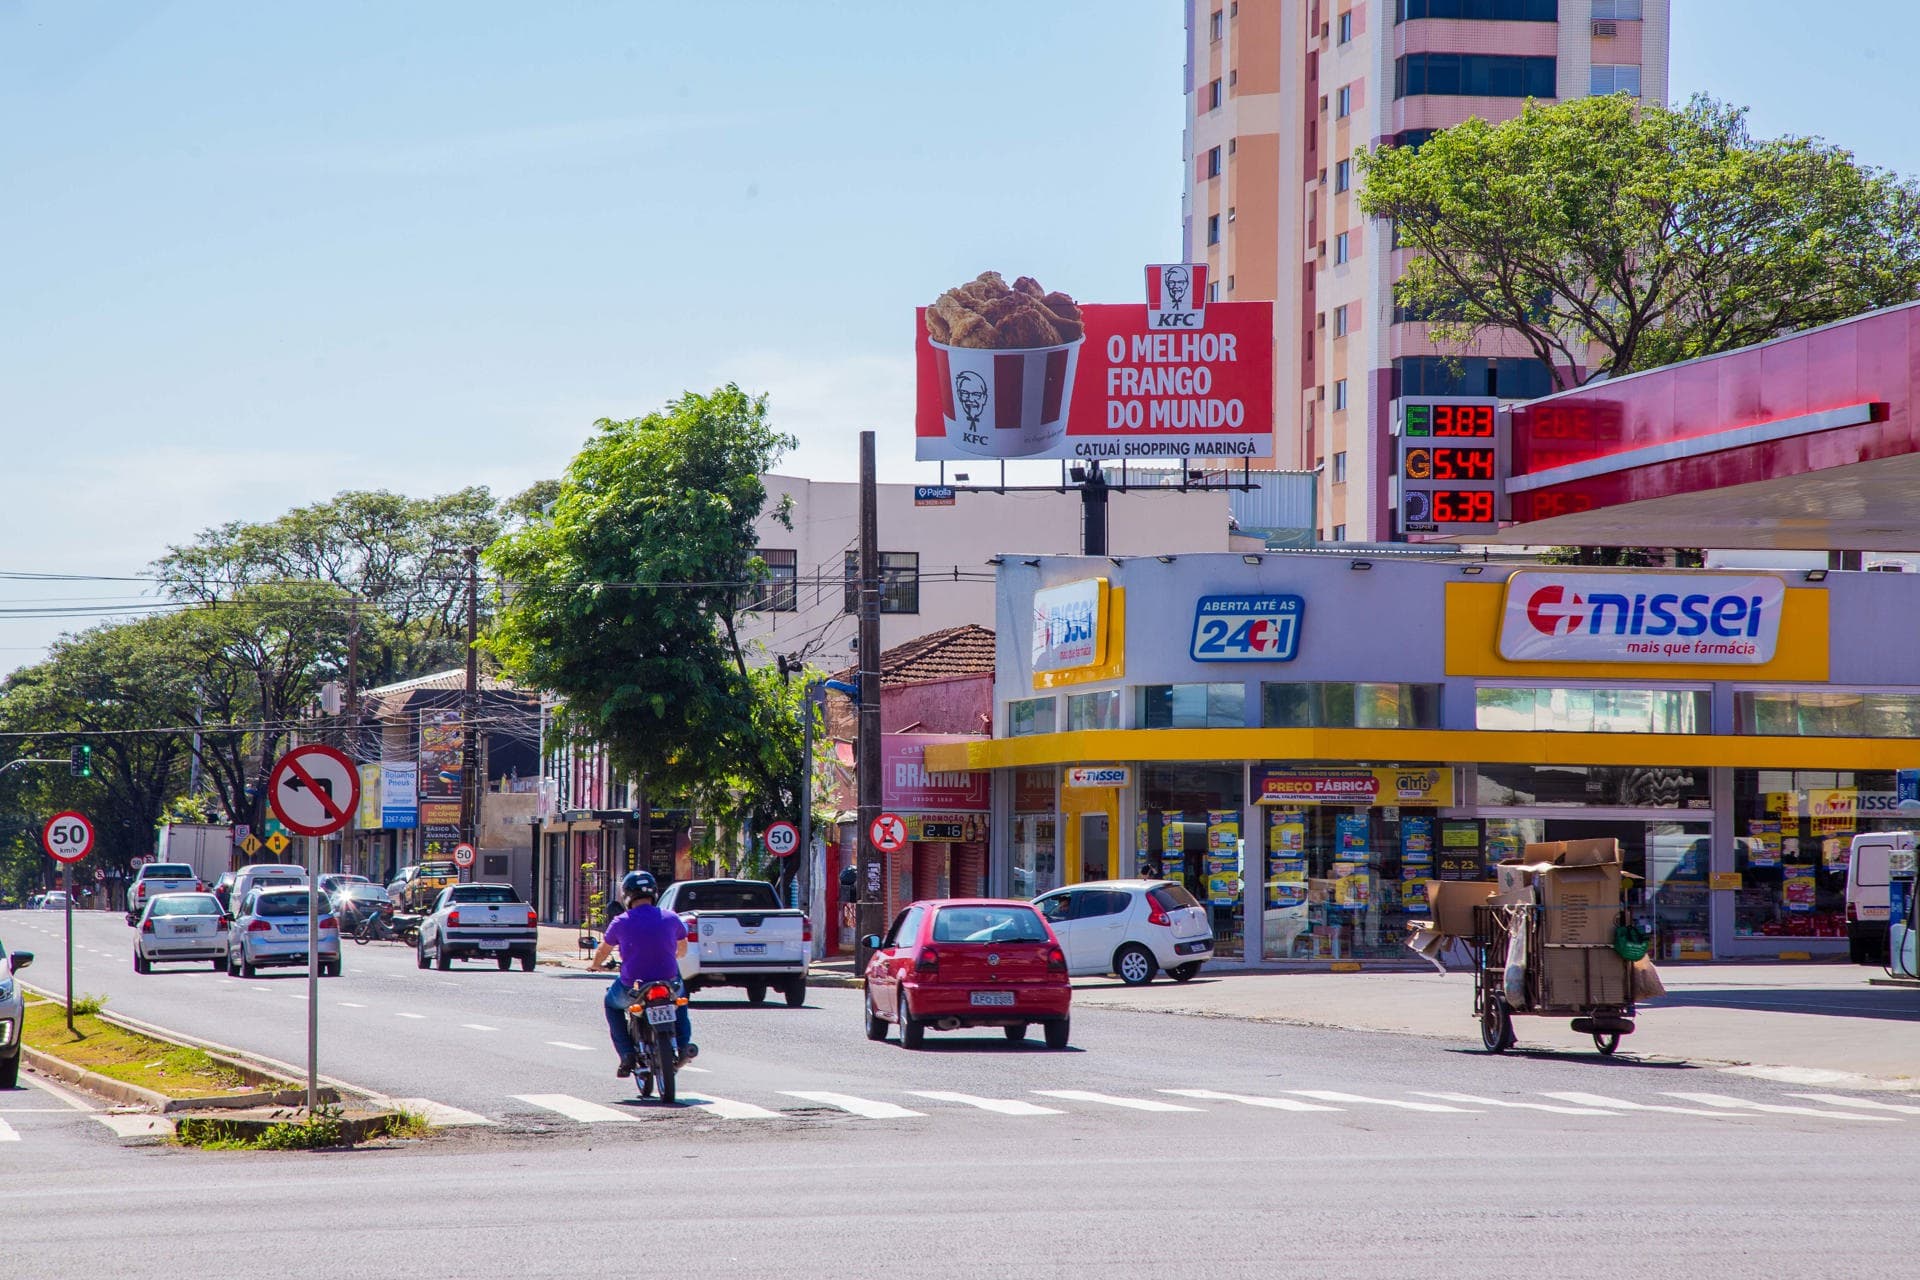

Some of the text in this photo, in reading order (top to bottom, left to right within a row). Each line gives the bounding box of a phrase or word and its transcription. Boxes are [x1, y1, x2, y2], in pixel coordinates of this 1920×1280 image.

[1157, 312, 1195, 327] KFC
[1107, 333, 1238, 364] O MELHOR
[1107, 366, 1213, 396] FRANGO
[1107, 399, 1245, 430] DO MUNDO
[1407, 406, 1493, 437] E 3.83
[962, 432, 989, 446] KFC
[1075, 438, 1257, 456] CATUAÍ SHOPPING MARINGÁ
[1405, 449, 1493, 479] G 5.44
[1433, 491, 1493, 522] 6.39
[1203, 598, 1296, 611] ABERTA ATÉ AS
[1587, 593, 1764, 637] nissei
[1626, 640, 1756, 657] mais que farmácia
[1268, 782, 1313, 793] PREÇO
[1397, 776, 1431, 791] Club
[921, 814, 965, 823] PROMOÇÃO
[52, 824, 85, 845] 50
[770, 830, 793, 845] 50
[457, 850, 472, 858] 50
